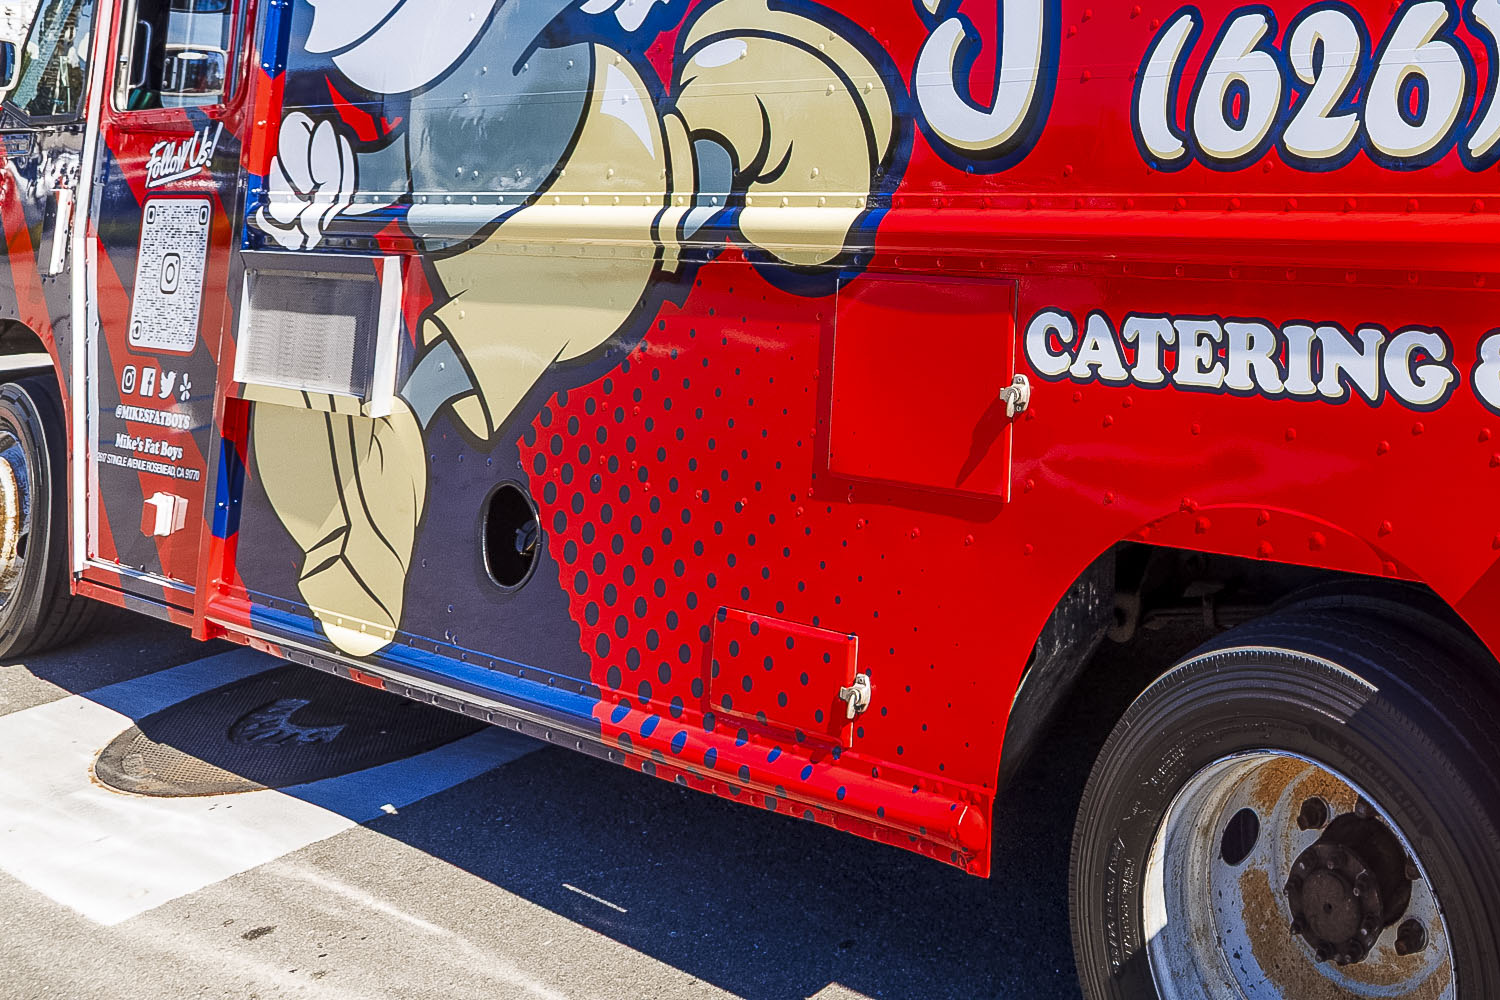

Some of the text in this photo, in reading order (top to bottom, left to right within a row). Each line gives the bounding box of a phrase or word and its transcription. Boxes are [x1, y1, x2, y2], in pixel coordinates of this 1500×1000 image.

[189, 121, 224, 168] Us!
[1024, 310, 1455, 407] CATERING
[115, 404, 191, 430] @MIKESFATBOYS
[115, 433, 184, 461] Mike's Fat Boys
[176, 468, 185, 478] CA
